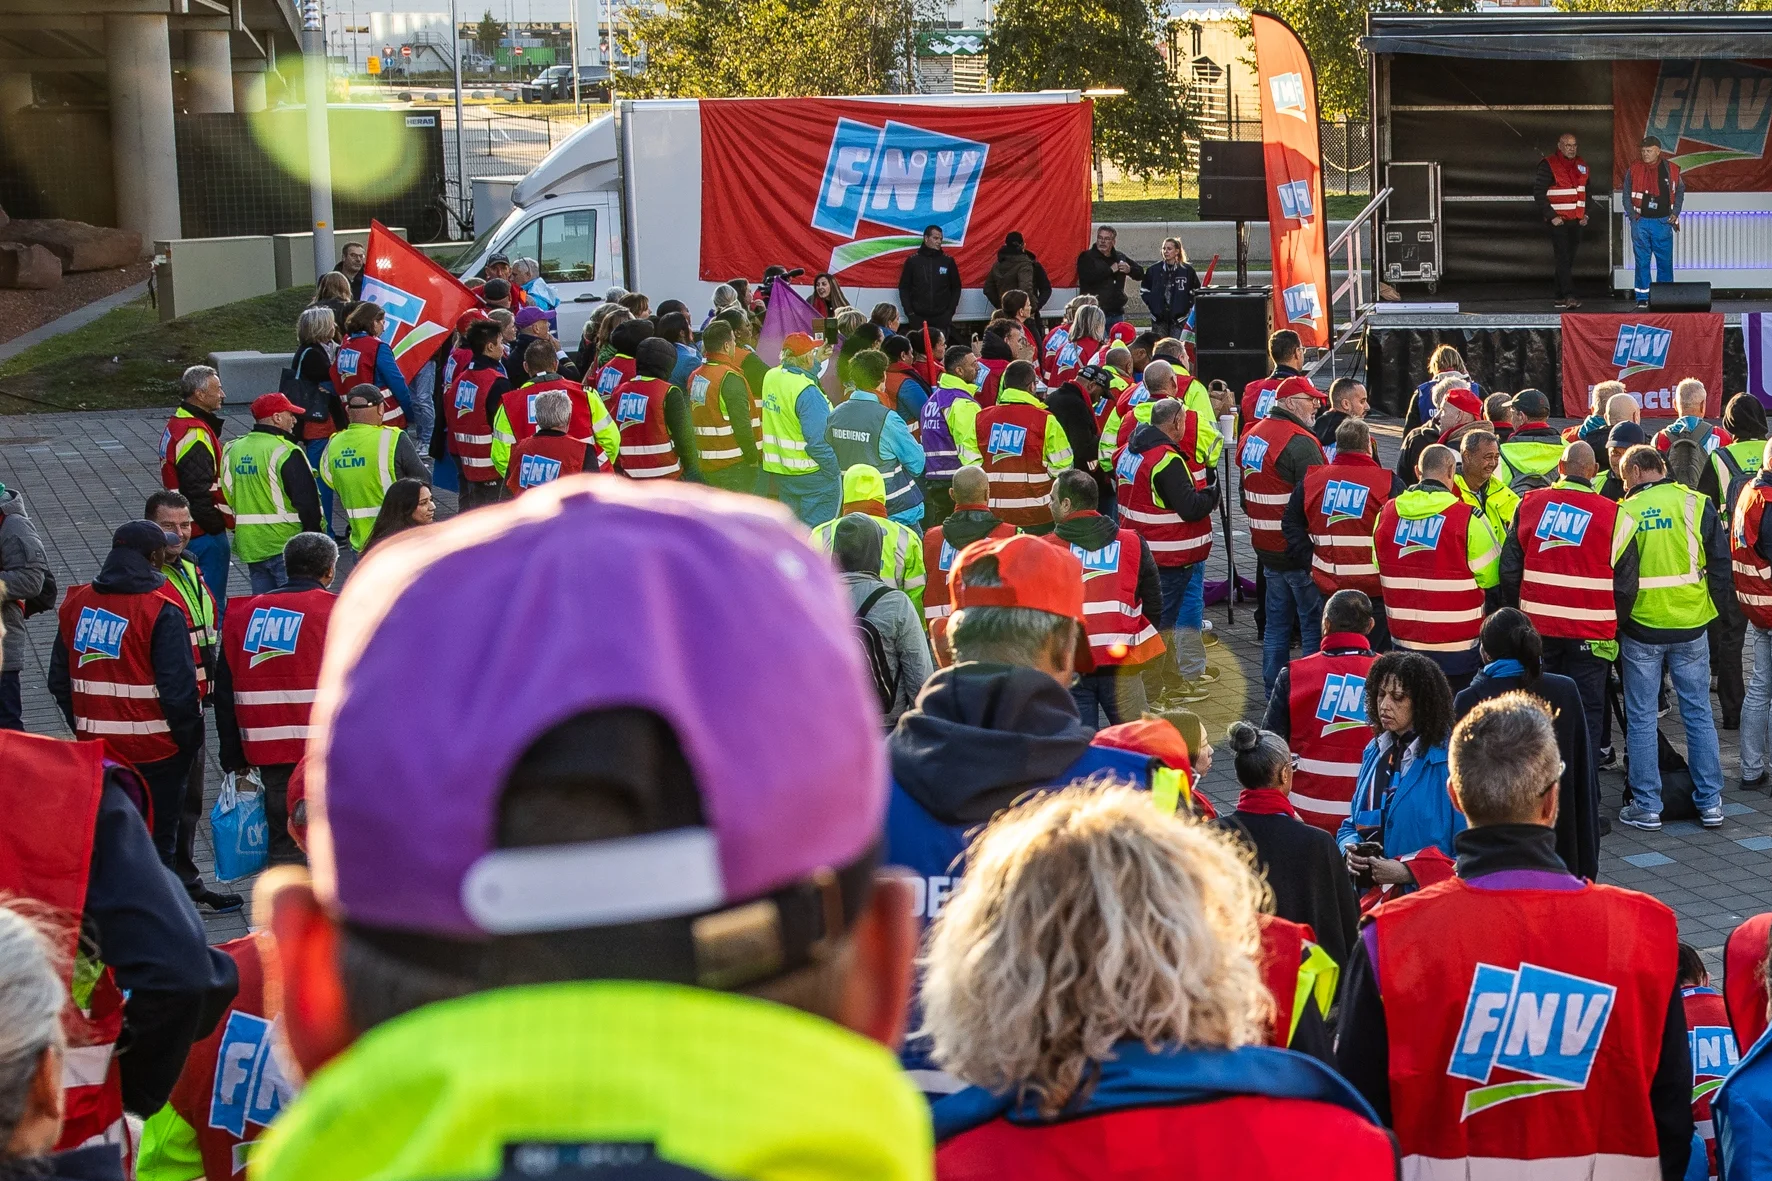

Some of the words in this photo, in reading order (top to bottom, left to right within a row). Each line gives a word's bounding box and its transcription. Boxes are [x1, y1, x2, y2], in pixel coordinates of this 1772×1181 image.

[406, 118, 434, 126] HERAS
[826, 147, 981, 212] FNV
[1175, 277, 1187, 290] T
[1617, 333, 1669, 358] FNV
[339, 352, 359, 372] FNV
[619, 396, 647, 416] FNV
[1629, 386, 1678, 409] acti
[991, 429, 1023, 448] FNV
[334, 457, 365, 468] KLM
[1242, 443, 1267, 467] FNV
[235, 465, 258, 475] KLM
[1324, 488, 1366, 509] FNV
[1396, 517, 1439, 540] FNV
[1540, 512, 1587, 536] FNV
[77, 617, 125, 646] FNV
[246, 616, 301, 642] FNV
[1322, 683, 1364, 713] FN
[1464, 990, 1609, 1060] FNV
